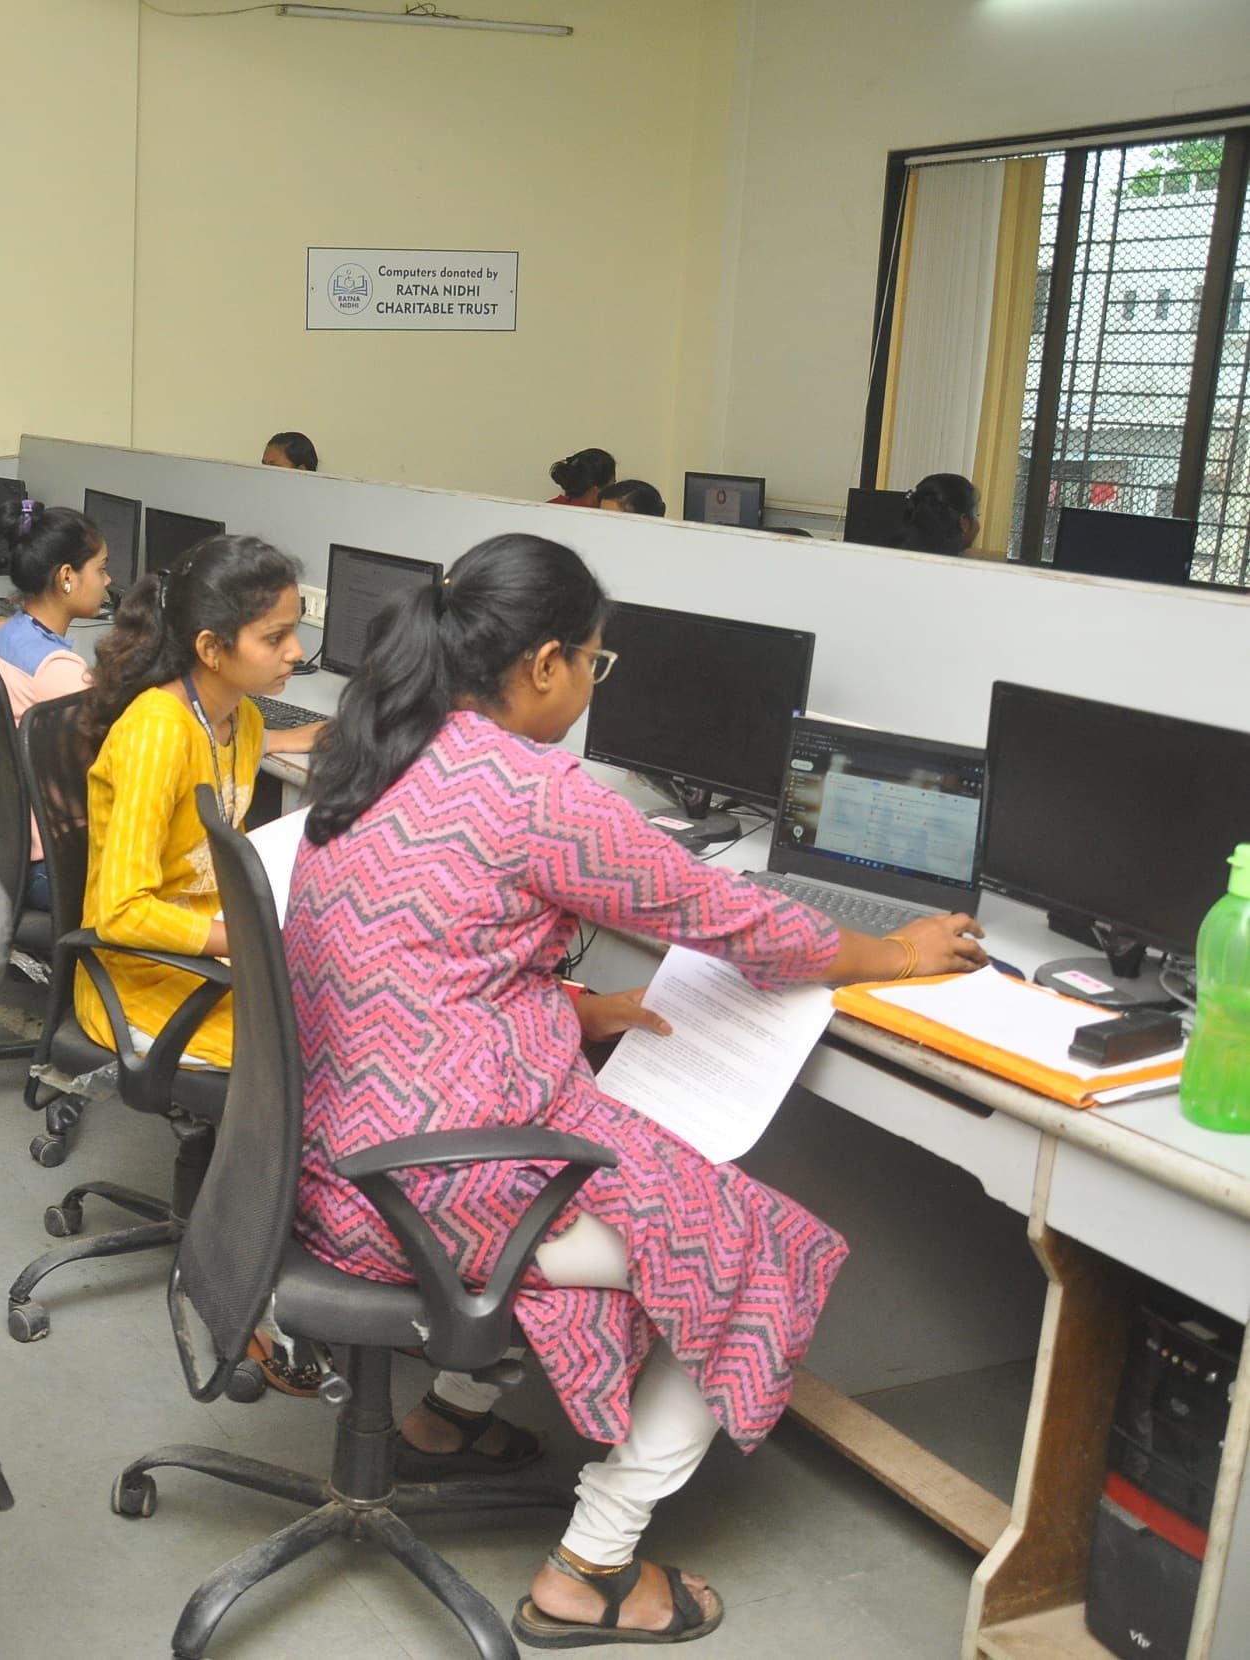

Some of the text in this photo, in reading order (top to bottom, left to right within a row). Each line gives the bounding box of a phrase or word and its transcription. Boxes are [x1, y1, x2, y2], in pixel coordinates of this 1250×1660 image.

[378, 265, 498, 280] Computers donated by
[396, 284, 480, 297] RATNA NIDHI
[376, 302, 498, 315] CHARITABLE TRUST
